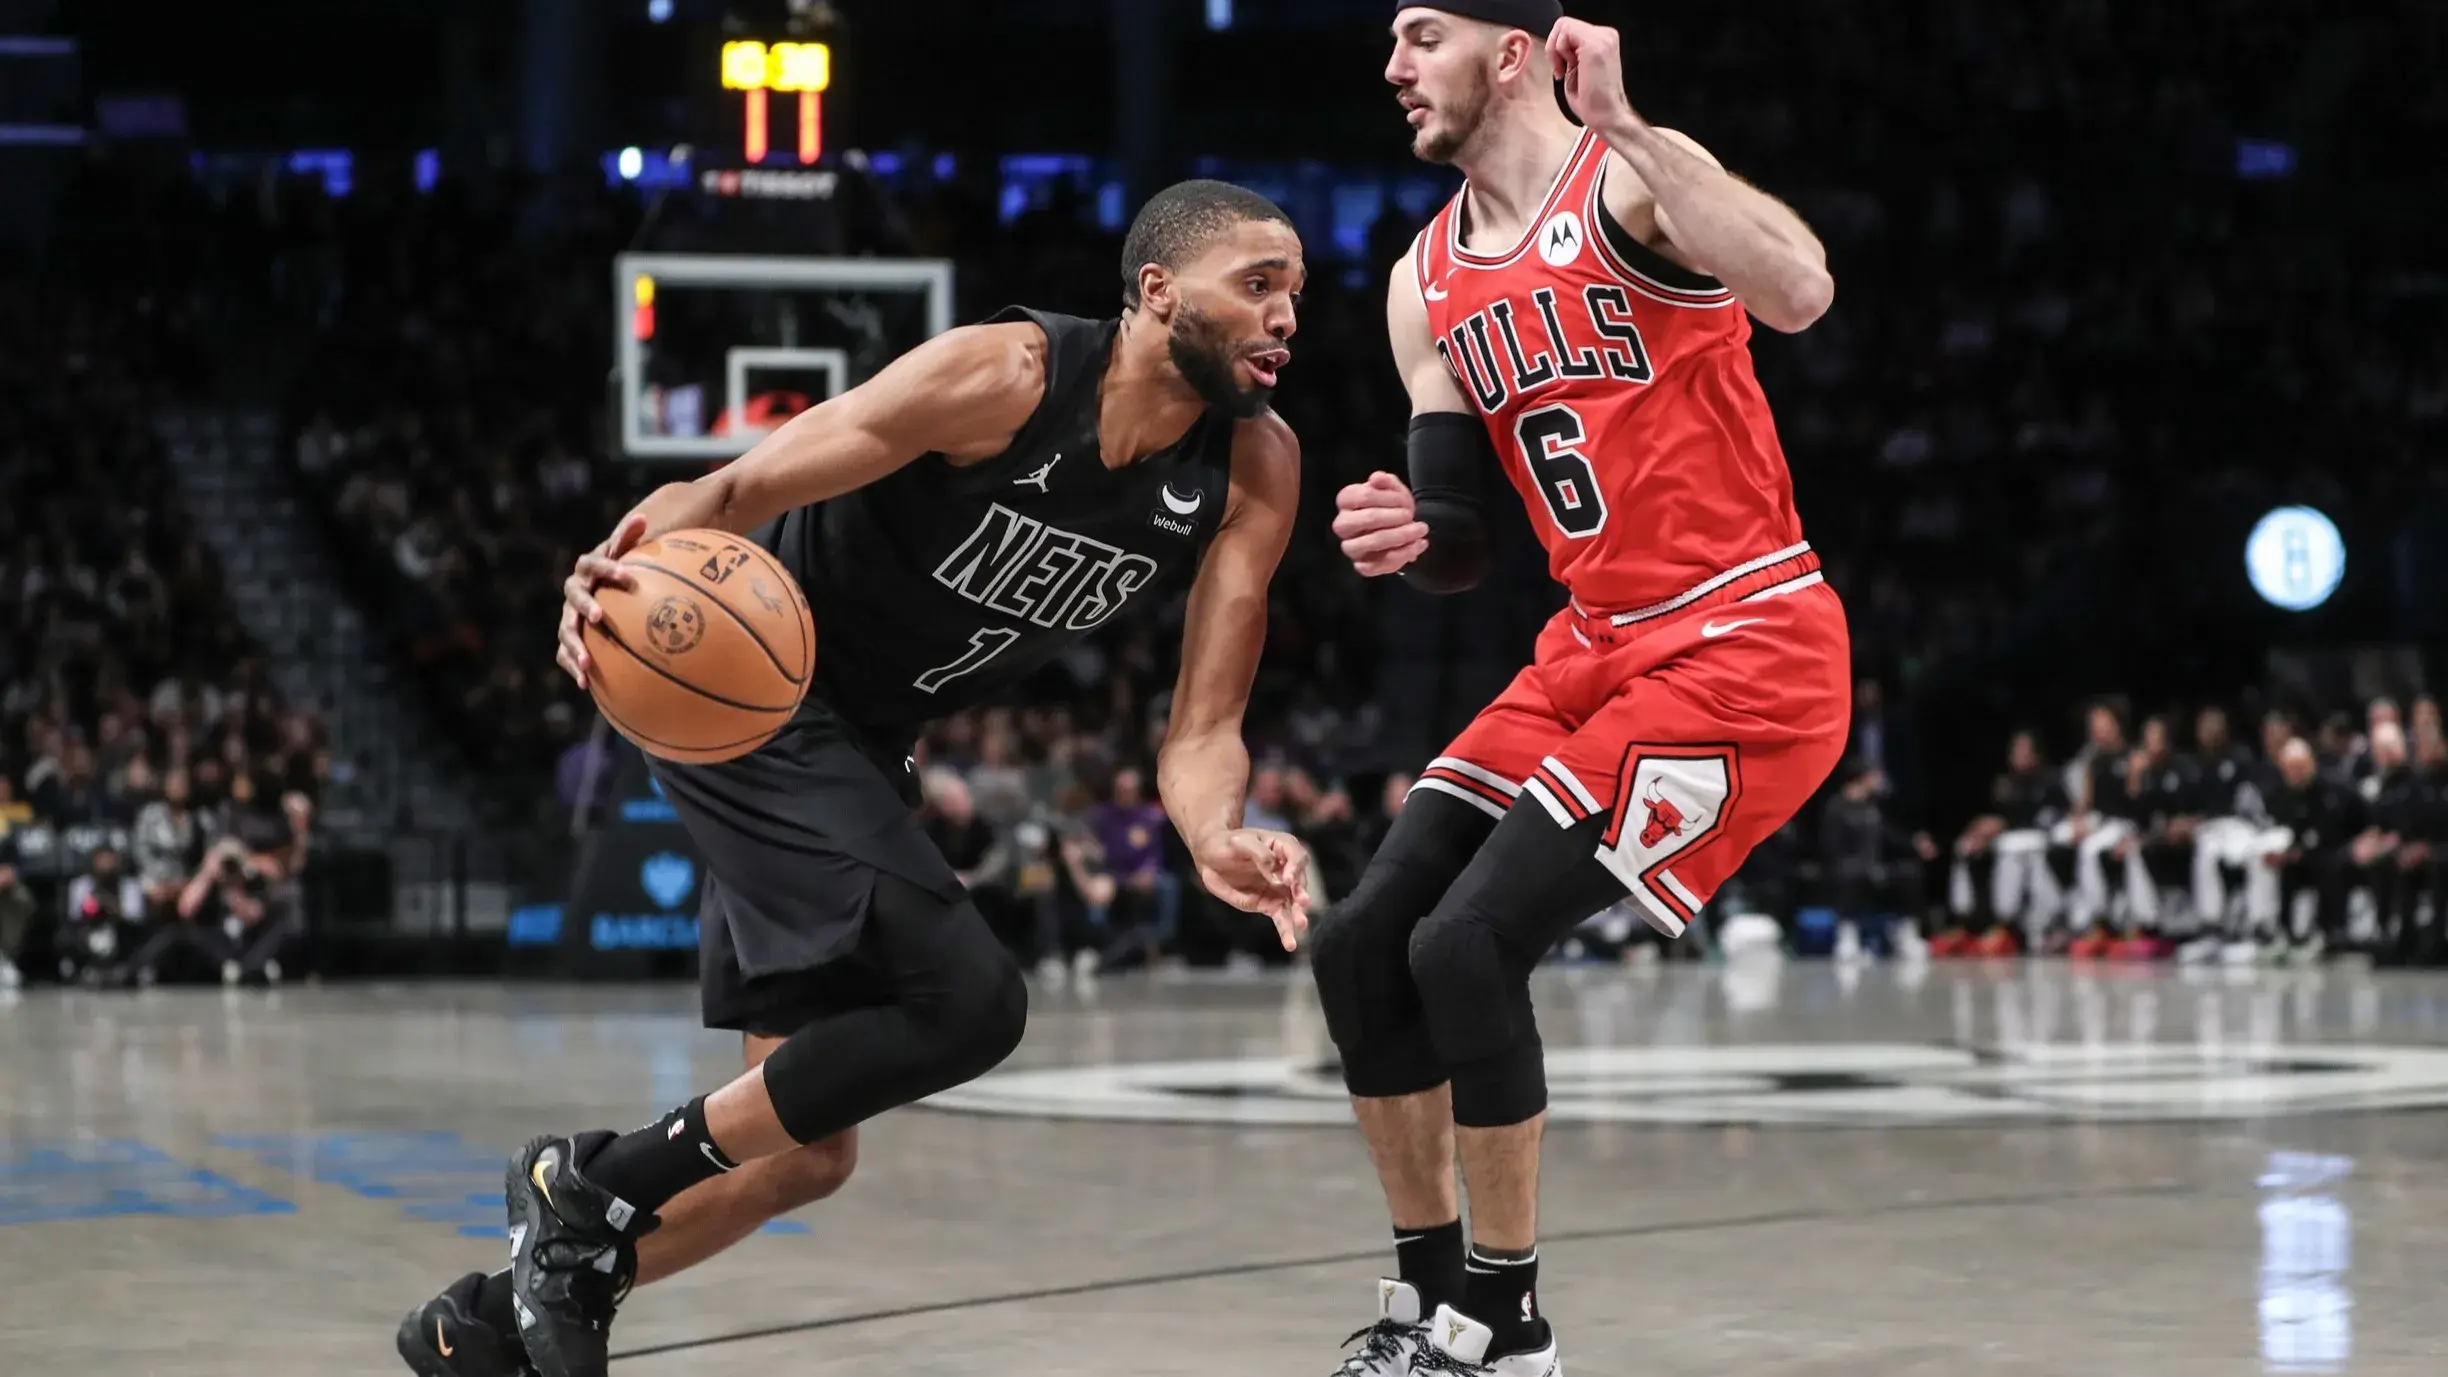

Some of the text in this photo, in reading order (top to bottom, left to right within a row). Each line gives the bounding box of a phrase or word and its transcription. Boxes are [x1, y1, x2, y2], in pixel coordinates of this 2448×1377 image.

[1513, 402, 1608, 540] 6
[931, 501, 1158, 630] NETS
[1153, 513, 1193, 536] Webull
[912, 626, 1021, 694] 1
